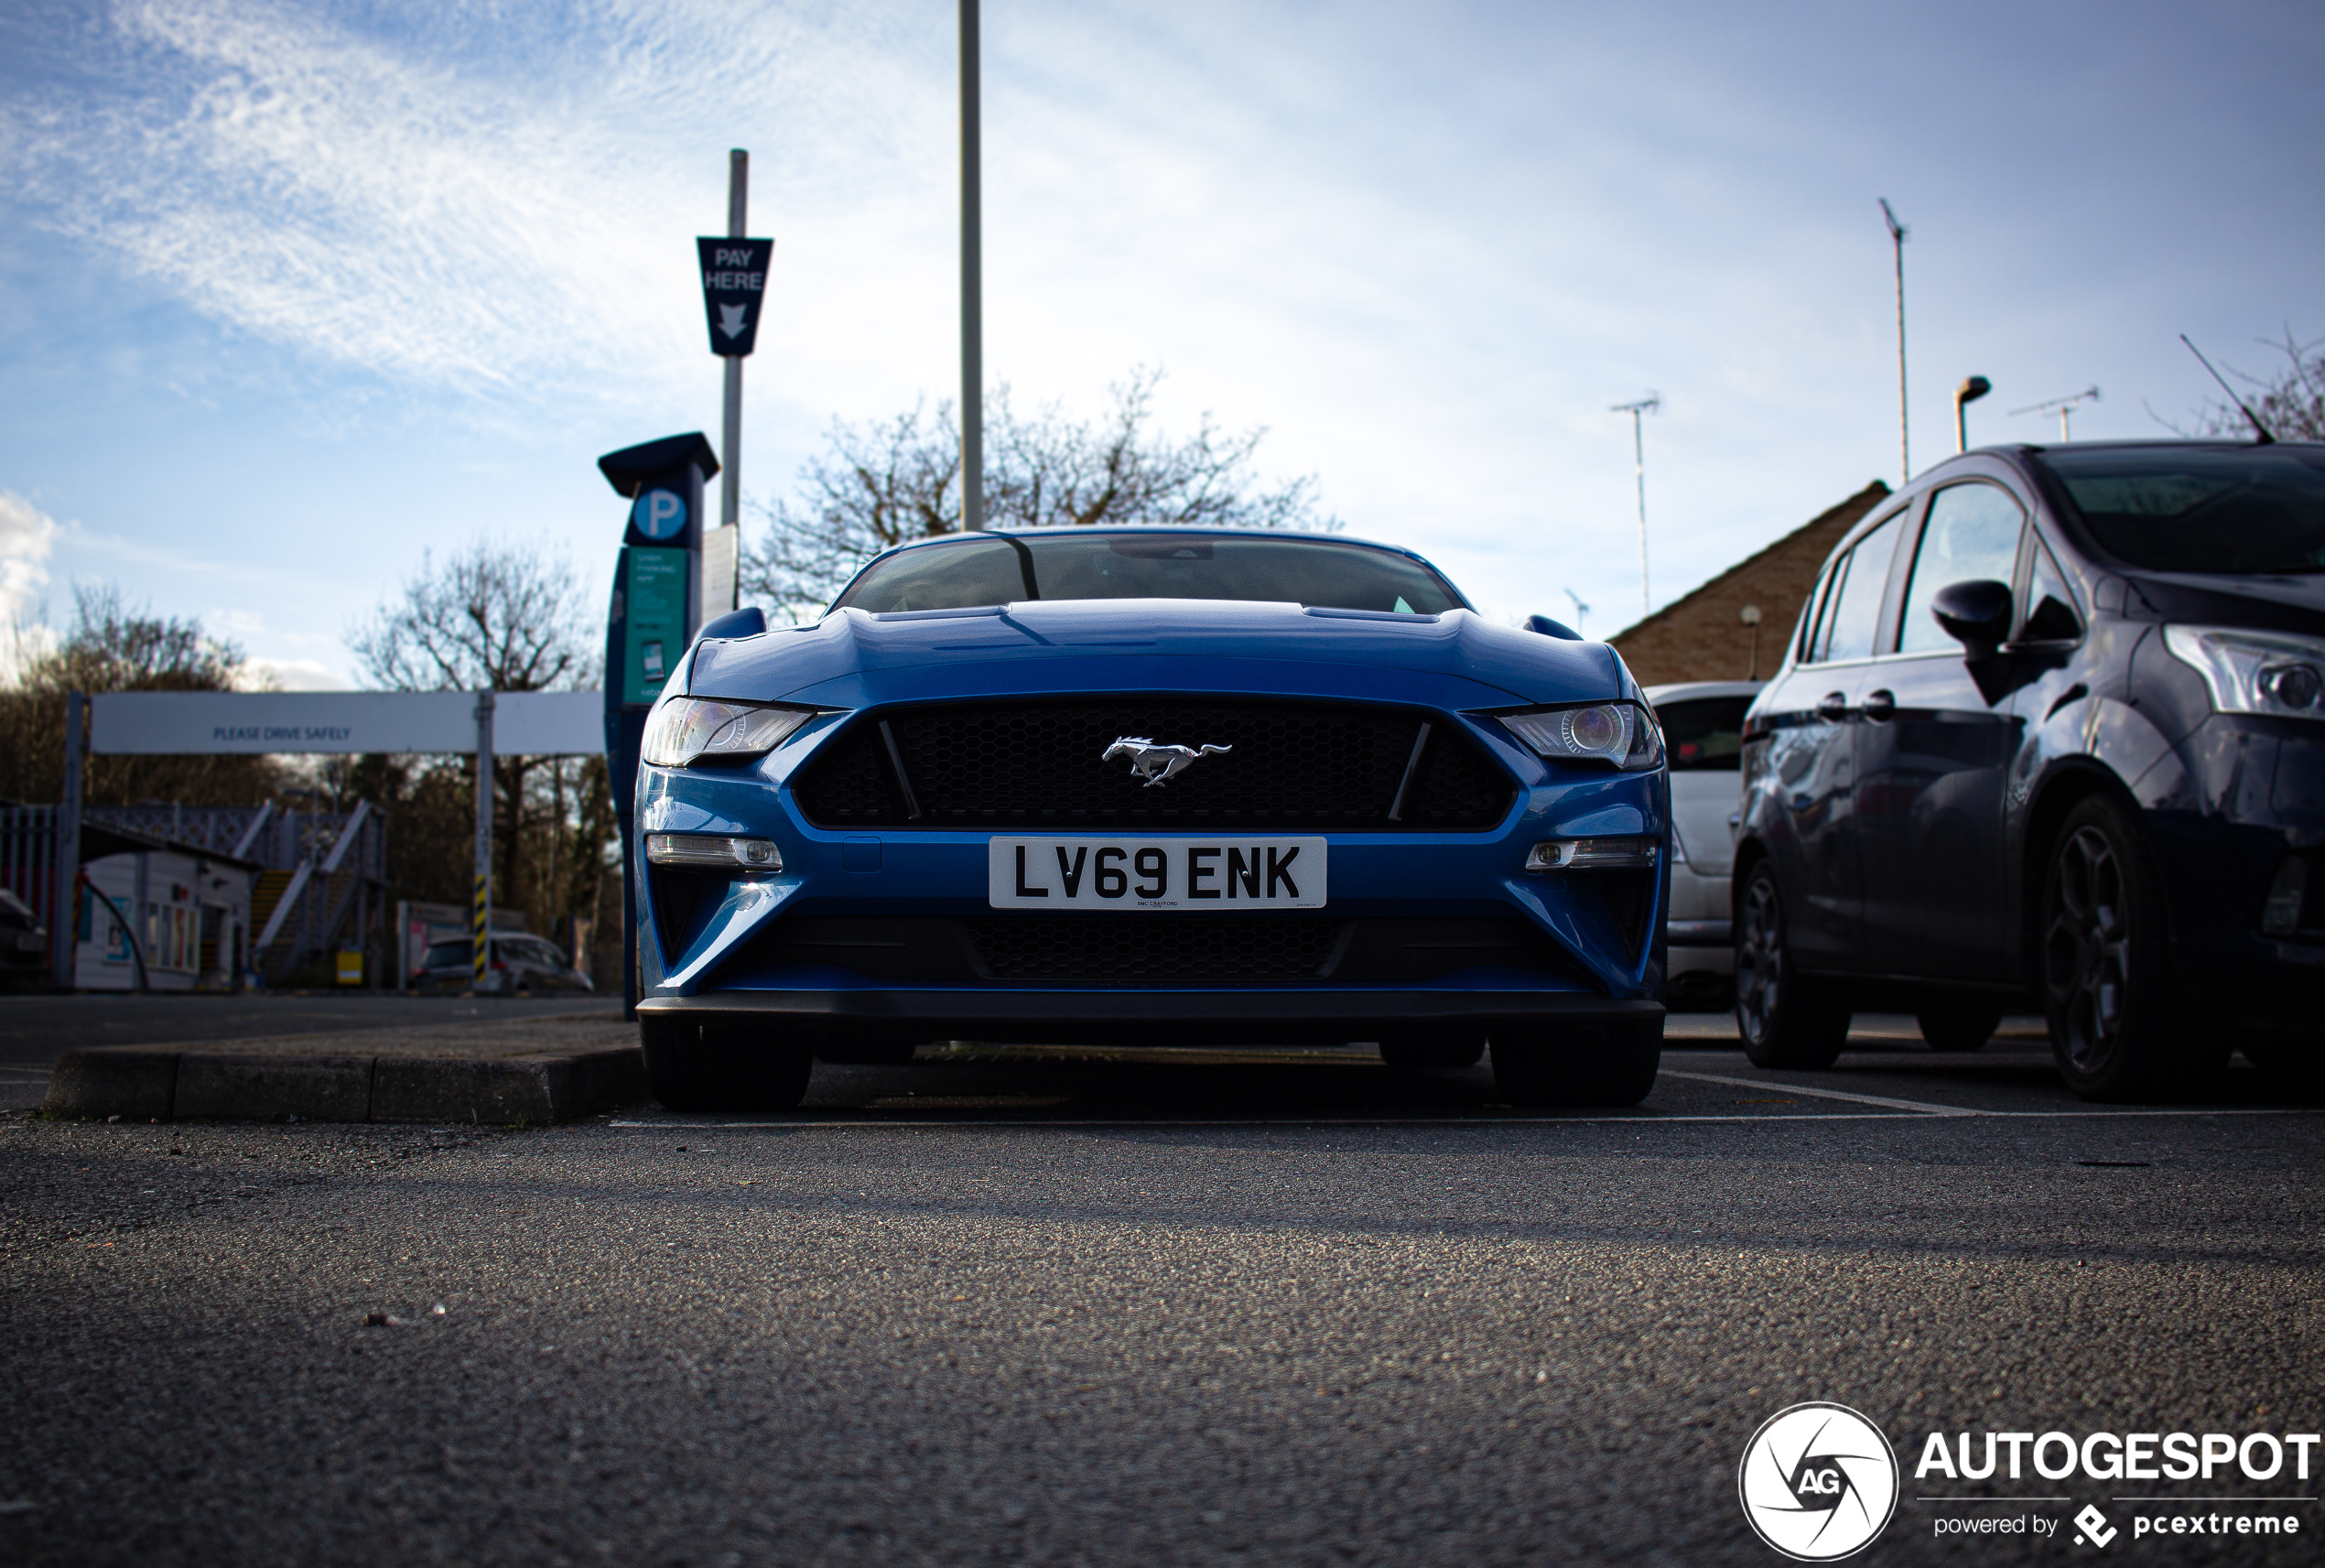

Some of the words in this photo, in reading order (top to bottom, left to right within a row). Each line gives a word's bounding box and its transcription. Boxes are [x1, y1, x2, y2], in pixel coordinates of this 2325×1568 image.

[715, 248, 753, 267] PAY
[705, 271, 763, 291] HERE
[649, 490, 679, 536] P
[213, 727, 259, 741] PLEASE
[263, 727, 301, 741] DRIVE
[304, 727, 351, 741] SAFELY
[1014, 845, 1168, 900] LV69
[1187, 846, 1301, 900] ENK
